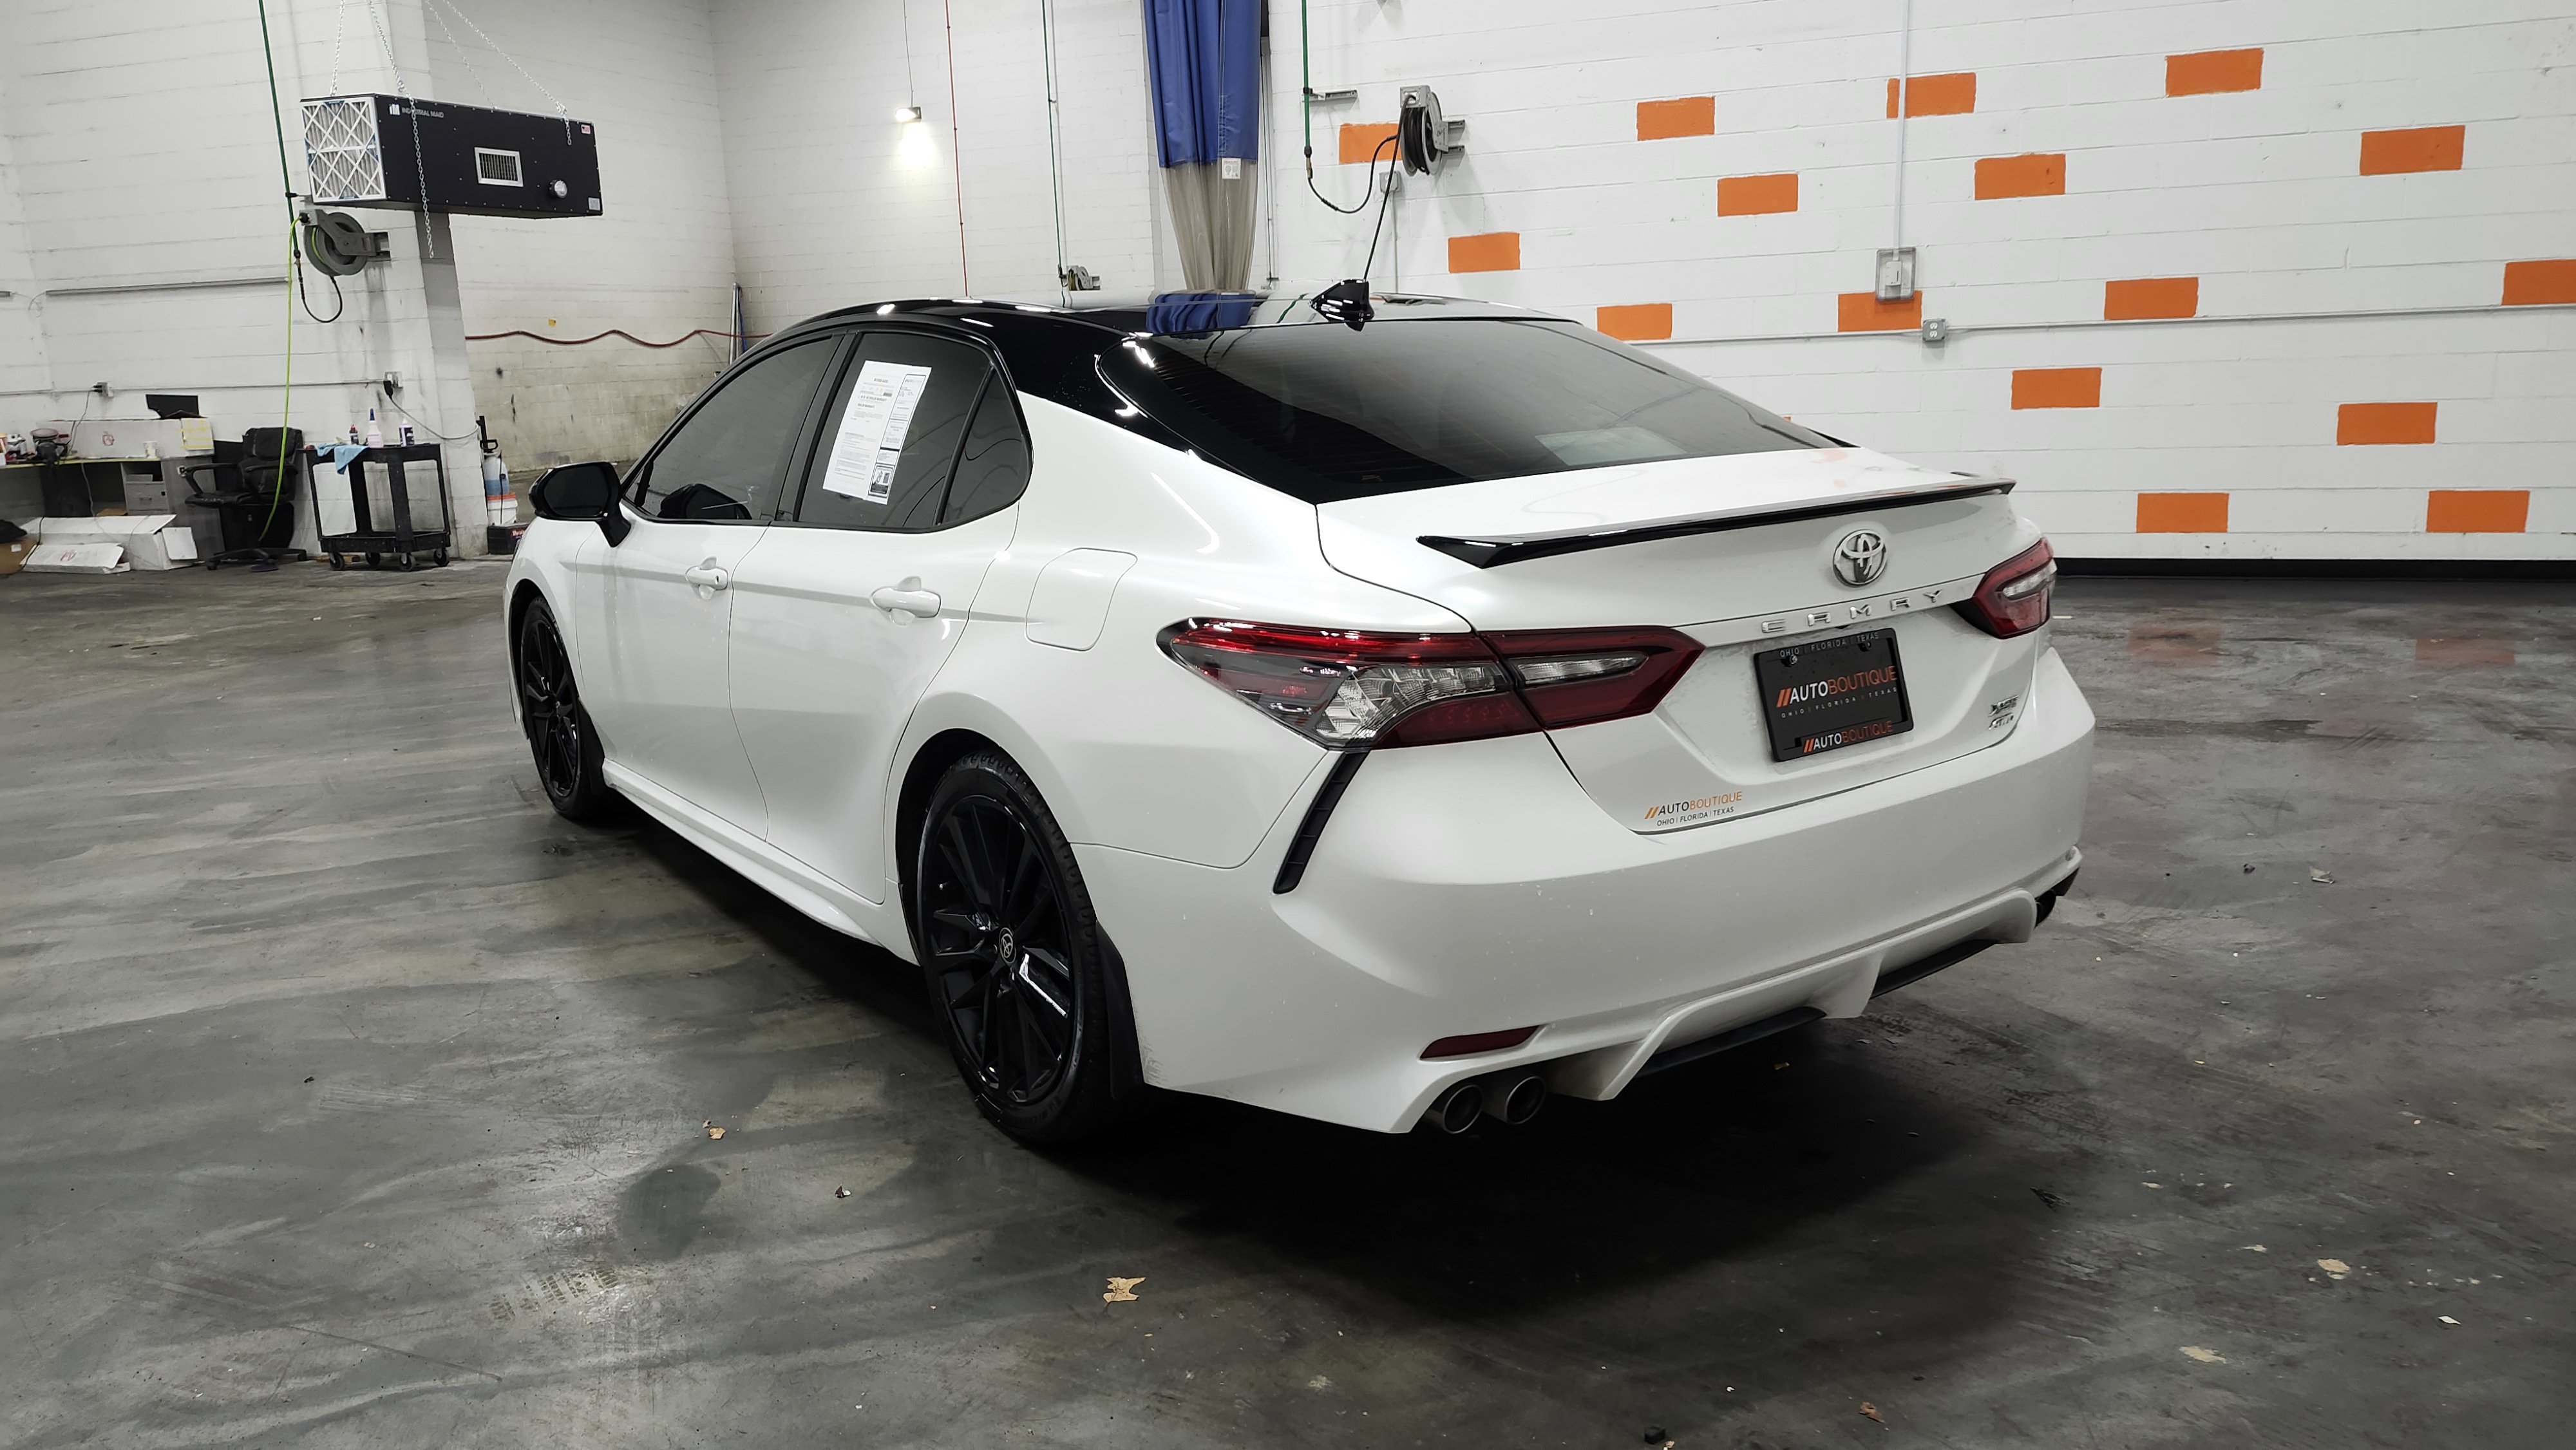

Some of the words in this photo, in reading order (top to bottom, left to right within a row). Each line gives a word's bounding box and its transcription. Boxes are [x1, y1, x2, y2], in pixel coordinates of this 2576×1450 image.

[401, 107, 430, 117] INDSTRIAL
[1761, 589, 1943, 634] CAMRY
[1779, 647, 1800, 657] OHIO
[1810, 639, 1846, 652] FLORIDA
[1856, 632, 1879, 643] TEXAS
[1790, 665, 1898, 704] AUTOBOUTIQUE
[1781, 708, 1804, 718] OHIO
[1815, 696, 1856, 710] FLORIDA
[1868, 686, 1897, 698] TEXAS
[1814, 720, 1893, 751] AUTOBOUTIQUE
[1656, 817, 1675, 827] OHIO
[1680, 811, 1709, 822] FLORIDA
[1713, 806, 1734, 816] TEXAS
[1658, 791, 1742, 816] AUTOBOUTIQUE
